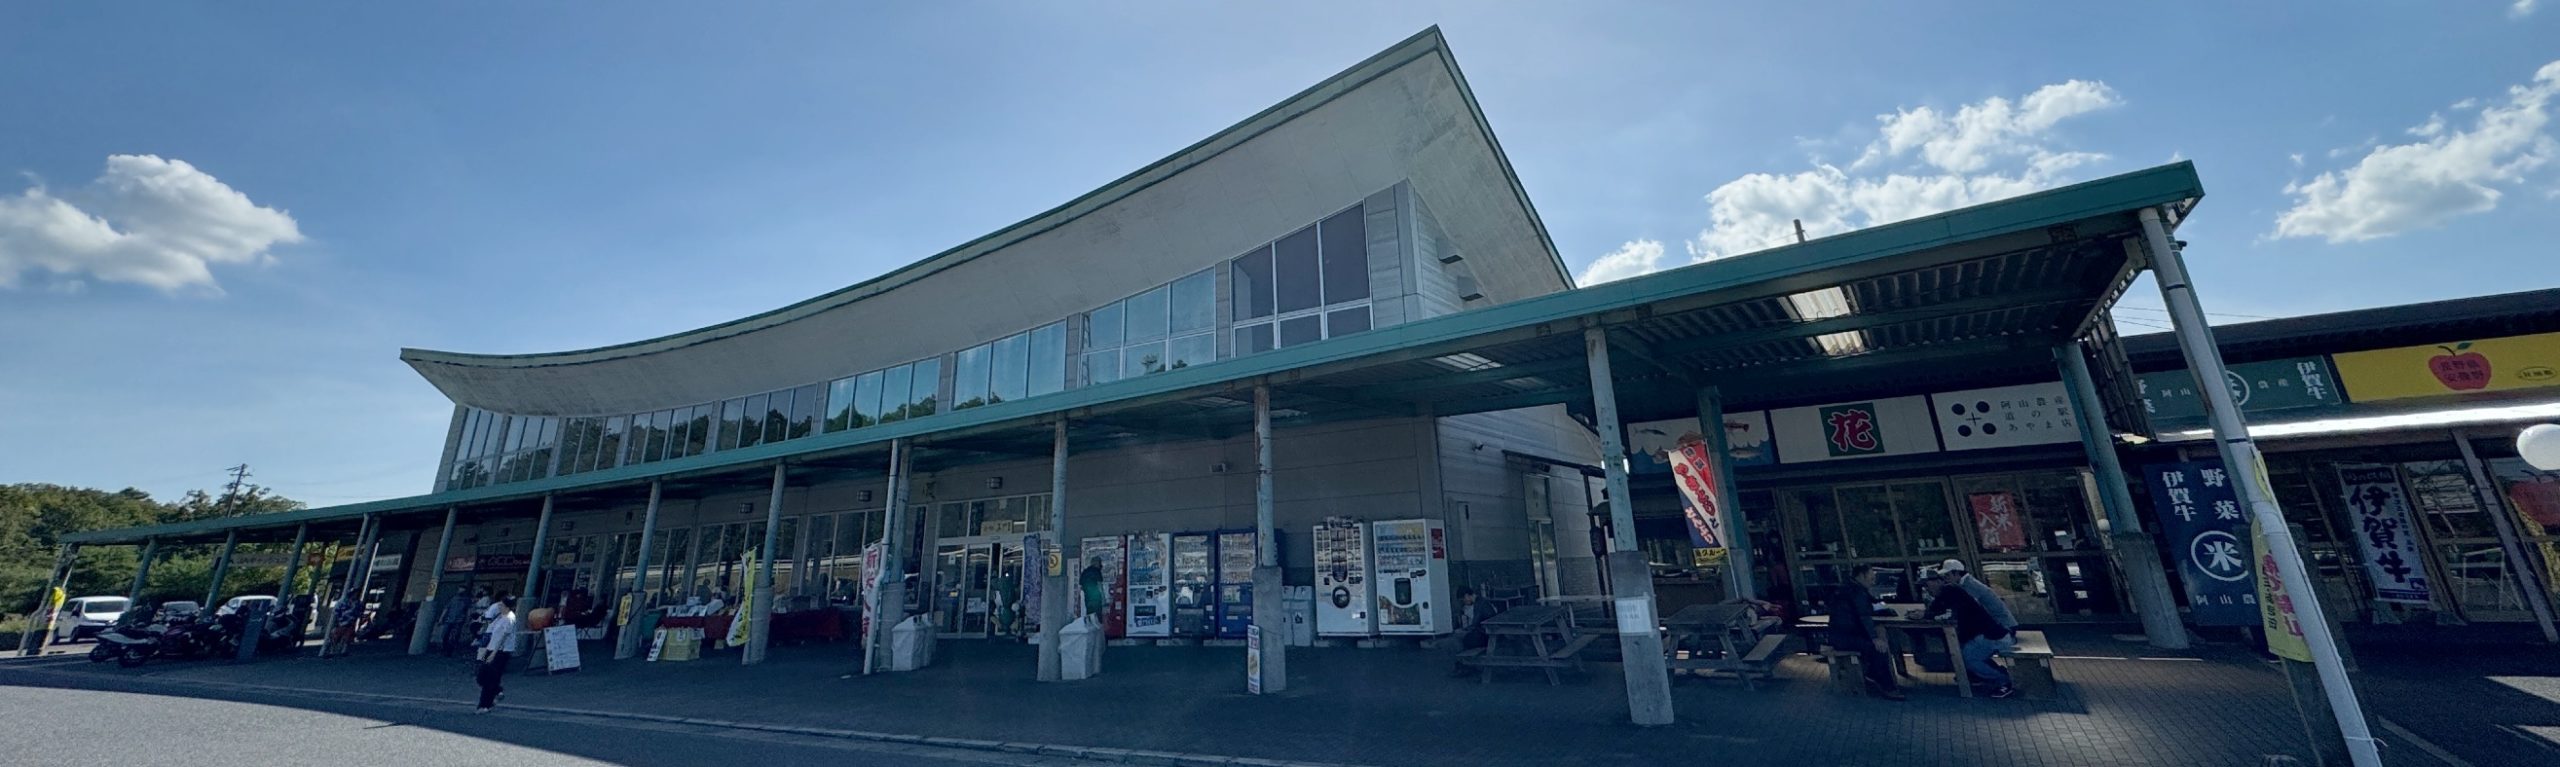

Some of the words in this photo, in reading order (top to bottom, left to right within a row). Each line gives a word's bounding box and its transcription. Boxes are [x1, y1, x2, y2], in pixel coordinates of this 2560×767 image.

[2297, 360, 2328, 400] 伊賀牛
[1829, 408, 1878, 452] 花
[1990, 494, 2013, 532] 新米
[2162, 470, 2198, 522] 伊賀牛
[2200, 467, 2240, 521] 野菜
[2203, 540, 2243, 572] 米
[2350, 485, 2412, 584] 伊賀牛
